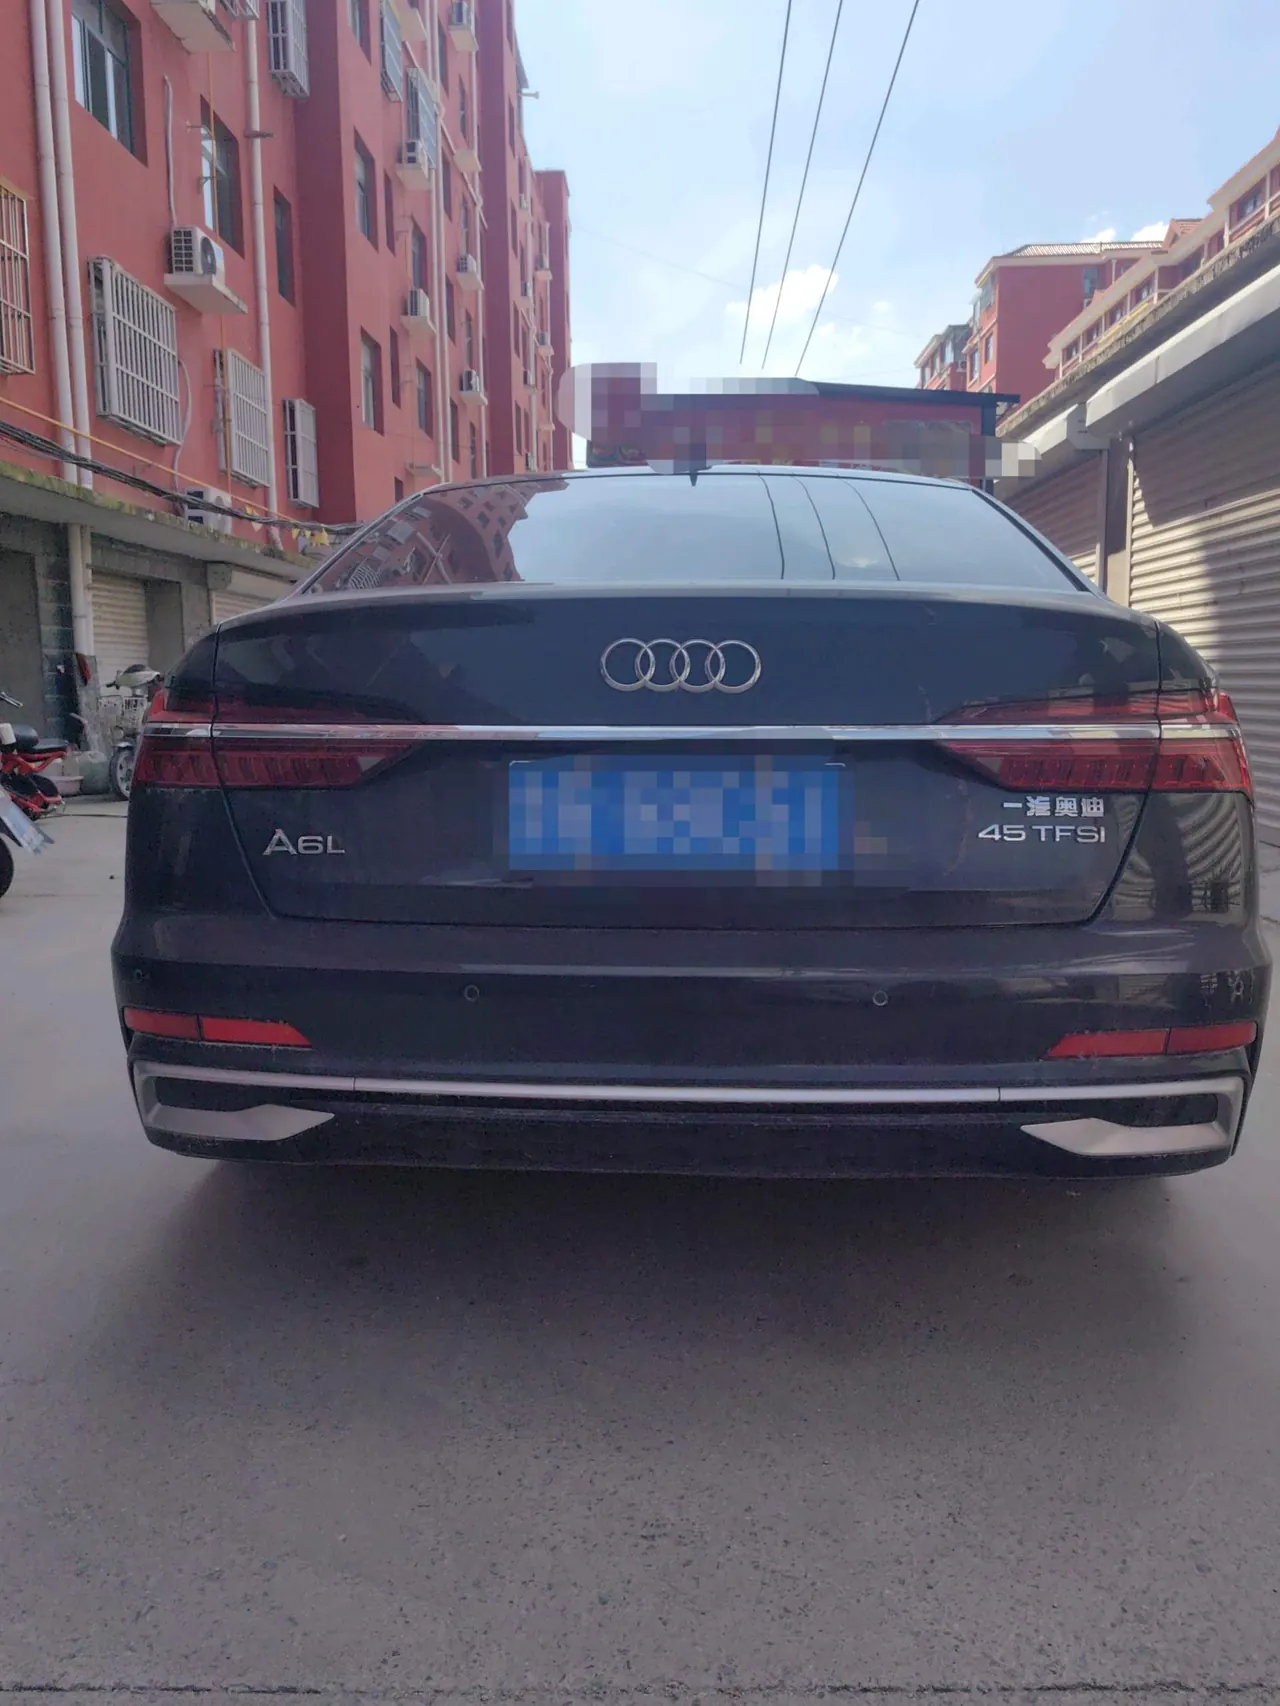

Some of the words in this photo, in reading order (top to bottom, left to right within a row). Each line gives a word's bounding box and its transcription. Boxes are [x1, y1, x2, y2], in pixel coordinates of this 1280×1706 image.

[1003, 796, 1104, 817] 一汽奥迪
[262, 828, 345, 855] A6L
[978, 824, 1026, 841] 45
[1032, 825, 1105, 843] TFSI
